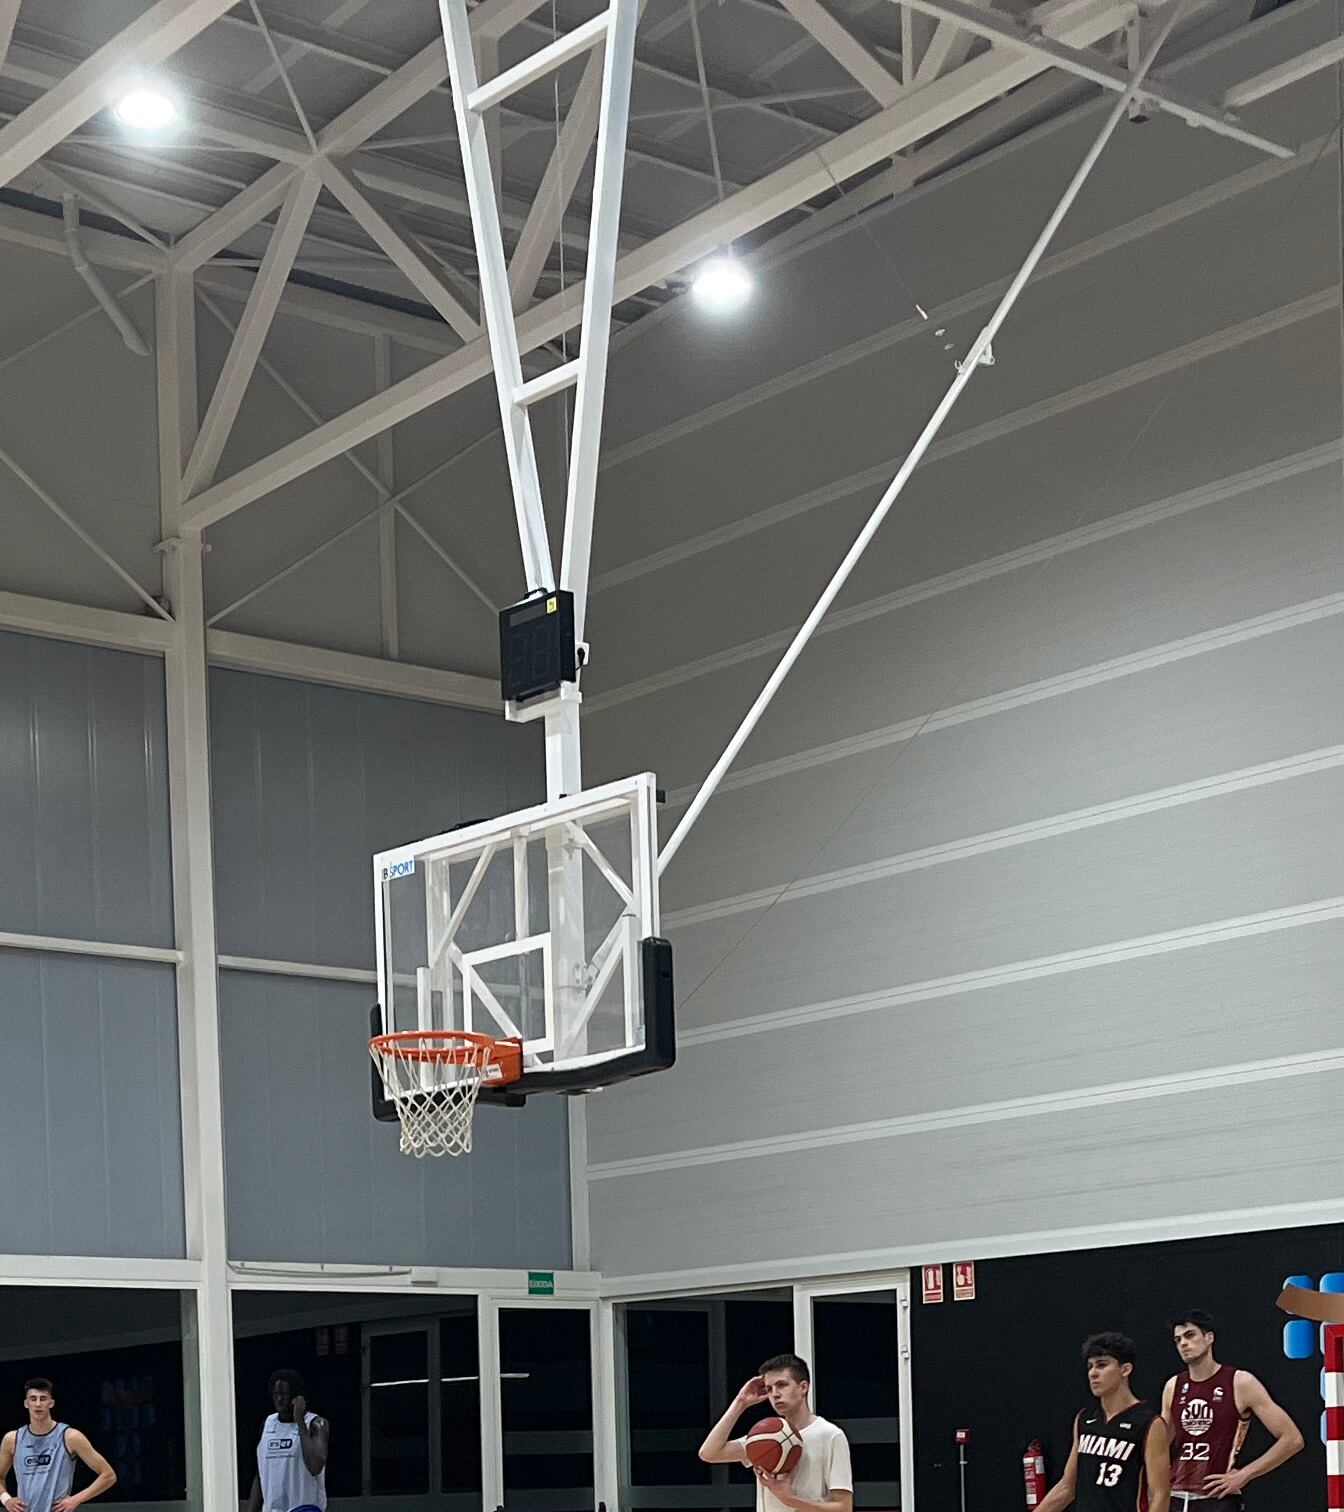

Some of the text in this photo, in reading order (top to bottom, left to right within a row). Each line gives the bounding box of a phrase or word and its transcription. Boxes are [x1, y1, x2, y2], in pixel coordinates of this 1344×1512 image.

[1077, 1434, 1136, 1461] MIAMI
[1179, 1442, 1210, 1460] 32
[1095, 1462, 1123, 1487] 13
